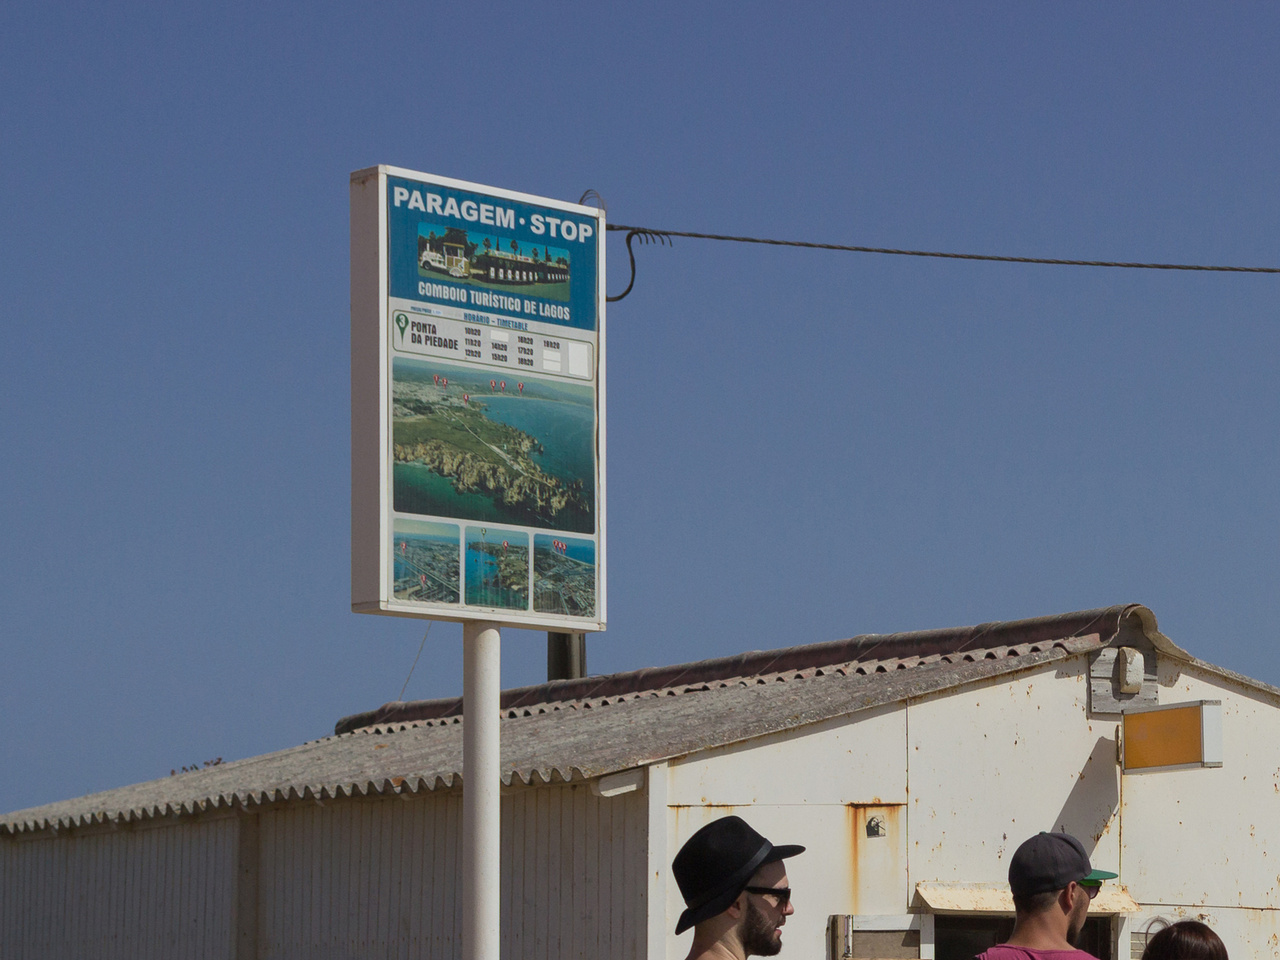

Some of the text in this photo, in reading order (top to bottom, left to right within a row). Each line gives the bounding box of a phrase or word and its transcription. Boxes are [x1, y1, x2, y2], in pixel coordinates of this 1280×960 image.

[394, 186, 593, 243] PARAGEM STOP
[418, 281, 571, 320] COMBOIO TURÍSTICO DE LAGOS
[411, 321, 437, 335] PONTA
[497, 318, 528, 331] TIMETABLE
[411, 333, 459, 350] DA PIEDADE
